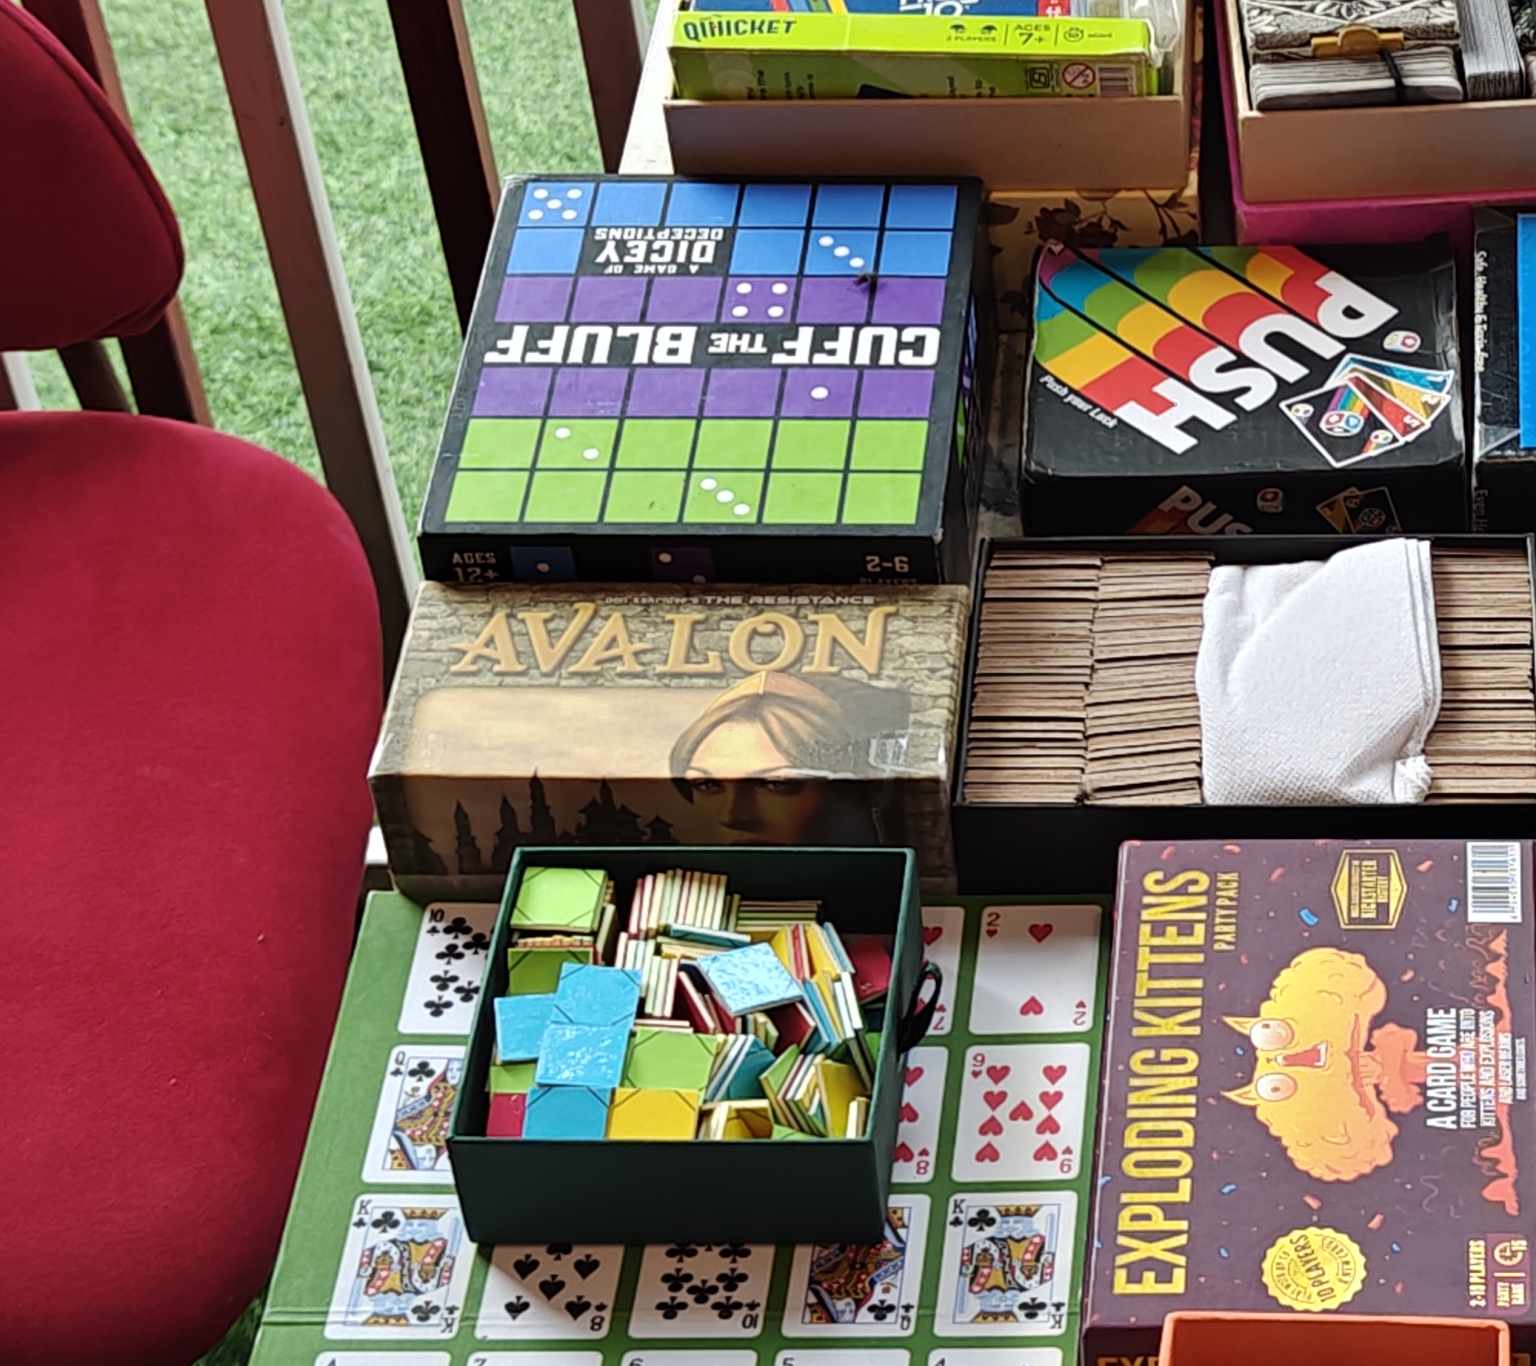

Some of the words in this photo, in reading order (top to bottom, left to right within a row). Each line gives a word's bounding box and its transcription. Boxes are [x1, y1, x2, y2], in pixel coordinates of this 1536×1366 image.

[1014, 23, 1051, 32] AGES
[1019, 32, 1046, 46] 7+
[594, 227, 725, 242] DECEPTIONS
[594, 241, 717, 265] DICEY
[603, 264, 625, 275] OF
[633, 264, 679, 275] GAME
[688, 264, 700, 275] A
[483, 325, 699, 366] BLUFF
[707, 333, 769, 356] THE
[771, 325, 942, 367] CUFF
[1111, 269, 1400, 455] PUSH
[1038, 373, 1068, 399] Push
[452, 551, 498, 566] AGES
[865, 554, 910, 574] 2-6
[704, 595, 744, 605] THE
[749, 595, 876, 605] RESISTANCE
[449, 602, 898, 675] AVALON
[1215, 870, 1240, 905] PACK
[985, 911, 1001, 927] 2
[1212, 904, 1240, 952] PARTY
[1131, 868, 1211, 1038] KITTENS
[1425, 1007, 1458, 1059] GAME
[971, 1053, 986, 1069] 9
[1425, 1061, 1458, 1113] CARD
[1425, 1116, 1458, 1130] A
[1112, 1046, 1200, 1296] EXPLODING
[357, 1199, 372, 1216] K
[951, 1198, 968, 1215] K
[1469, 1239, 1486, 1283] PLAYERS
